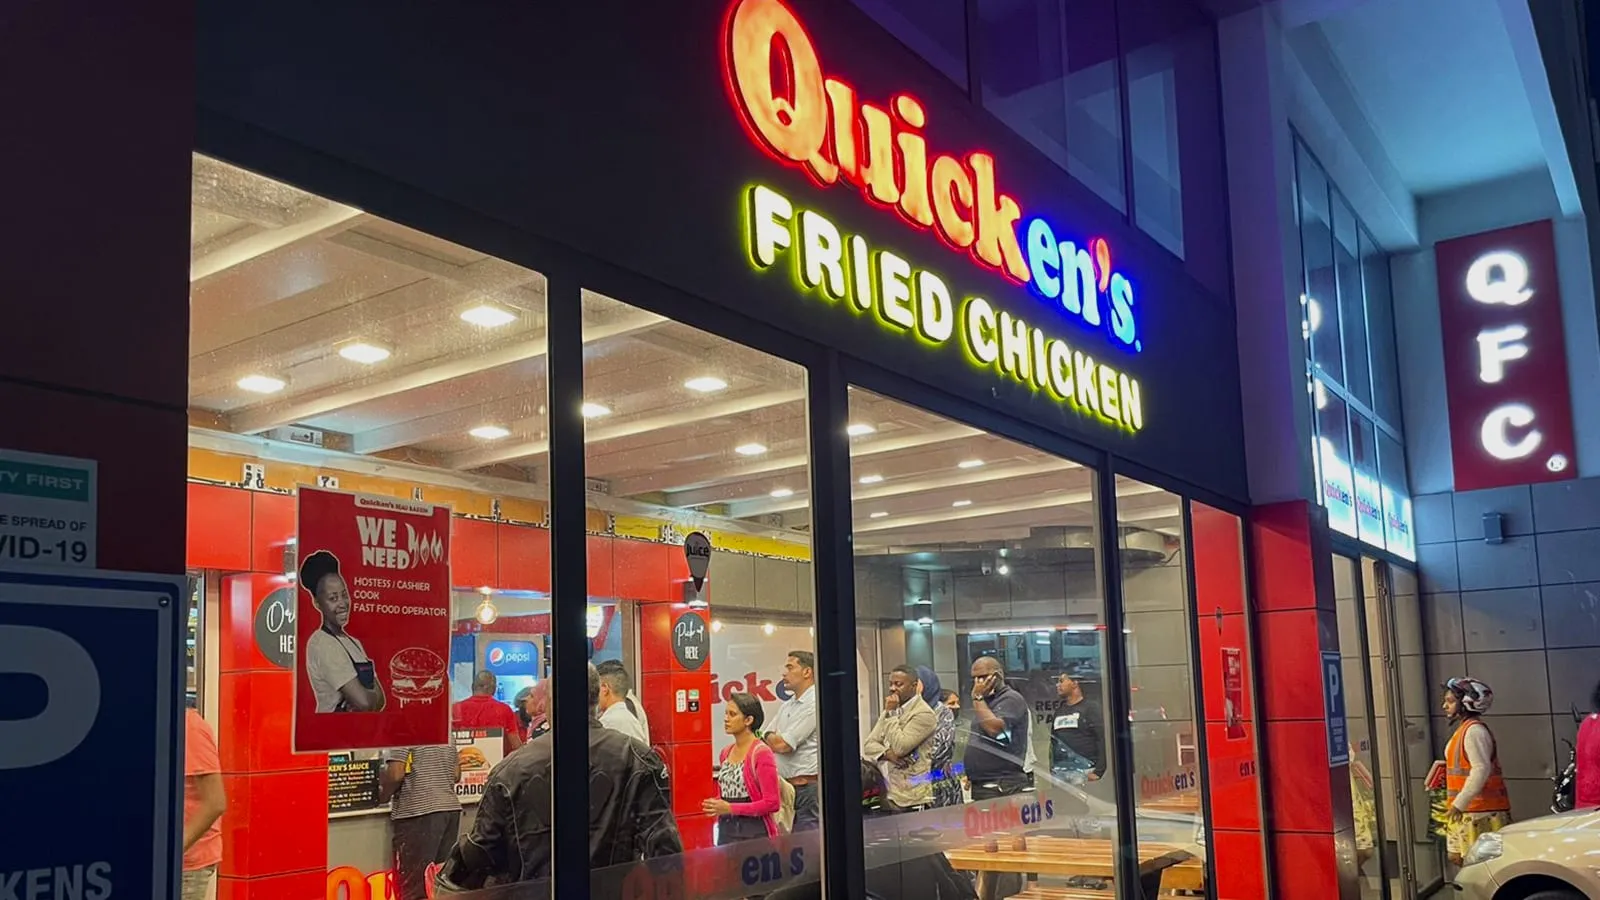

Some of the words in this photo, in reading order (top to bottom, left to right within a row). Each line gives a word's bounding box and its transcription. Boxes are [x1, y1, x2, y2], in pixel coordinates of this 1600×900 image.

[748, 184, 954, 343] FRIED
[964, 296, 1144, 430] CHICKEN
[26, 473, 84, 490] FIRST
[11, 515, 66, 530] SPREAD
[70, 521, 88, 531] OF
[355, 515, 397, 547] WE
[362, 545, 410, 570] NEED
[354, 576, 391, 589] HOSTESS
[397, 580, 430, 592] CASHIER
[353, 590, 380, 600] COOK
[353, 602, 375, 613] FAST
[376, 604, 400, 615] FOOD
[401, 605, 447, 617] OPERATOR
[280, 634, 295, 654] HE
[505, 651, 530, 664] pepsi
[1328, 664, 1340, 713] P
